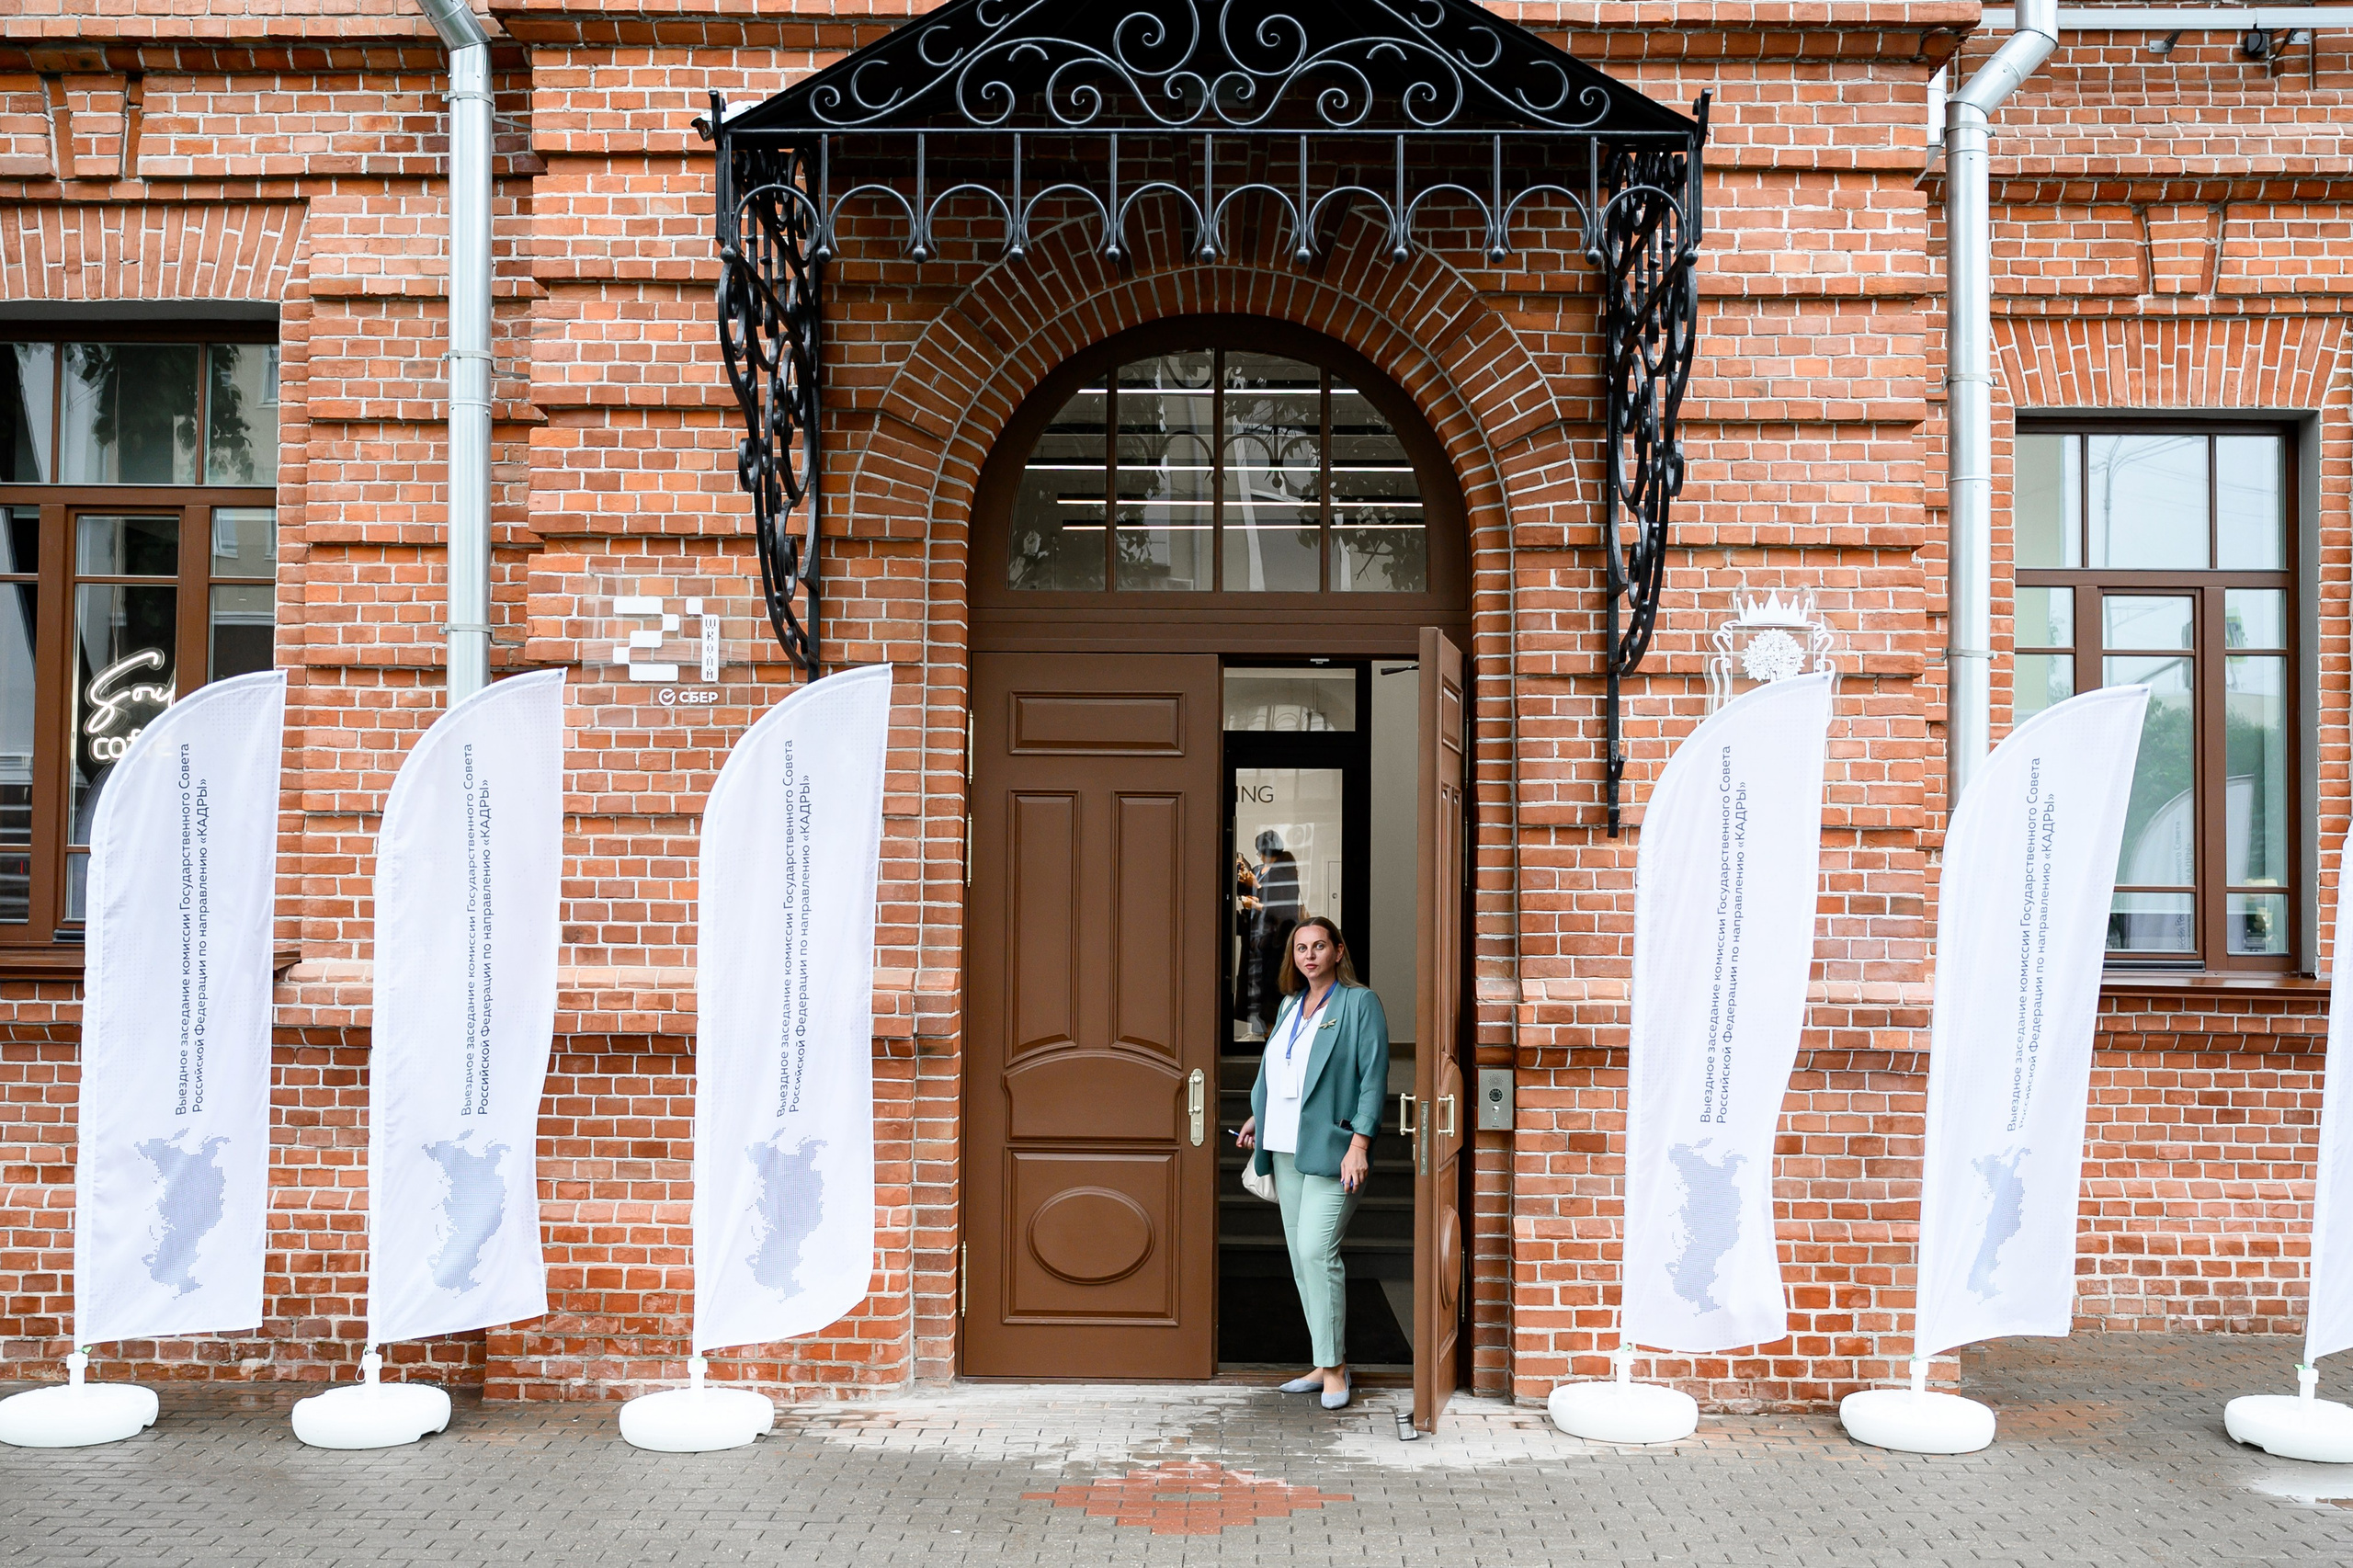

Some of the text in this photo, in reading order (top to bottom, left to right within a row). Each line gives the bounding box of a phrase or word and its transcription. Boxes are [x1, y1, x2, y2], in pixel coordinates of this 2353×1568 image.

[679, 691, 719, 703] СБЕР
[2040, 793, 2056, 859] «КАДРЫ»
[176, 744, 194, 1115] Выездное заседание комиссии Государственного Совета
[192, 778, 210, 1112] Российской Федерации по направлению «КАДРЫ»
[460, 744, 479, 1116] Выездное заседание комиссии Государственного Совета
[477, 779, 494, 1115] Российской Федерации по направлению «КАДРЫ»
[777, 739, 797, 1118] Выездное заседание комиссии Государственного Совета
[789, 775, 813, 1113] Российской Федерации по направлению «КАДРЫ»
[1699, 745, 1732, 1123] Выездное заседание комиссии Государственного Совета
[1716, 781, 1748, 1124] Российской Федерации по направлению «КАДРЫ»
[2006, 757, 2040, 1131] Выездное заседание комиссии Государственного Совета
[2028, 976, 2044, 1052] Федерации
[2036, 957, 2045, 973] по
[2038, 862, 2052, 953] направлению
